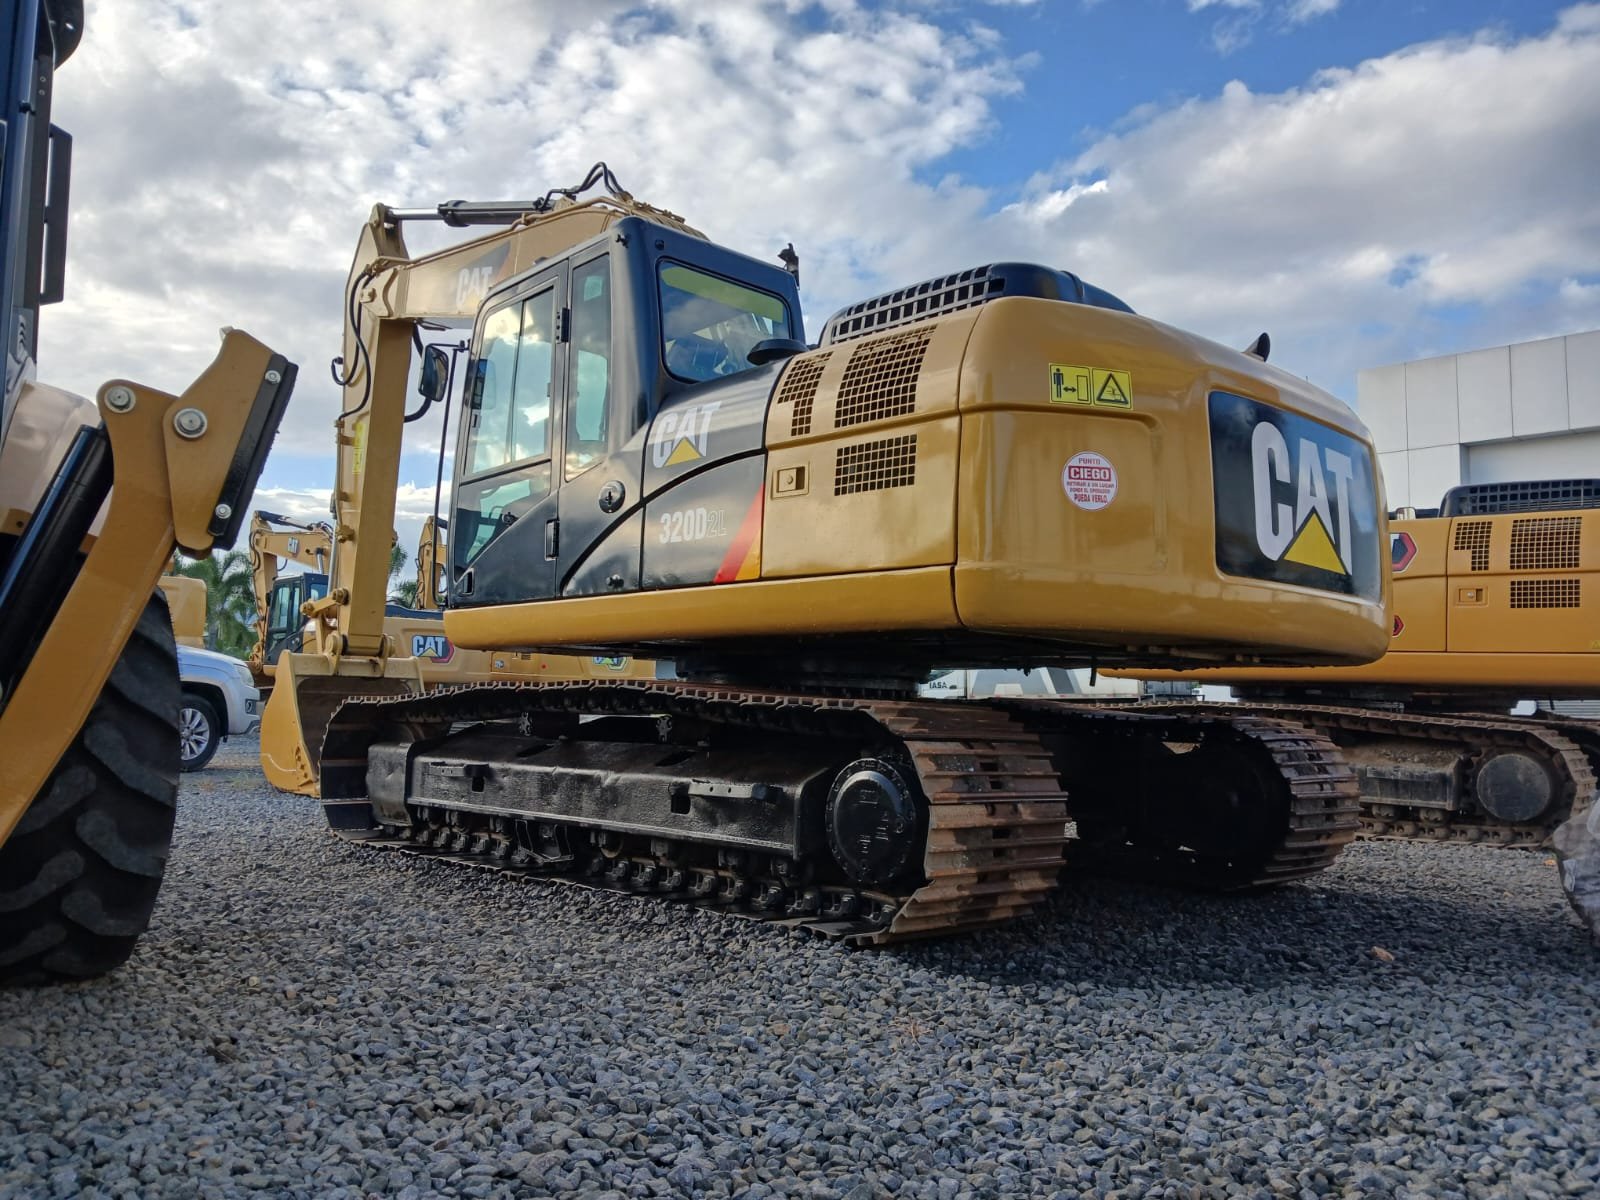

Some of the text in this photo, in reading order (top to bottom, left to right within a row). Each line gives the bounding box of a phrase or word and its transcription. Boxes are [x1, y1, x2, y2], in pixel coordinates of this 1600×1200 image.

[456, 266, 493, 311] CAT
[652, 401, 721, 468] CAT
[1070, 467, 1109, 480] CIEGO
[1251, 420, 1353, 576] CAT
[412, 635, 445, 657] CAT
